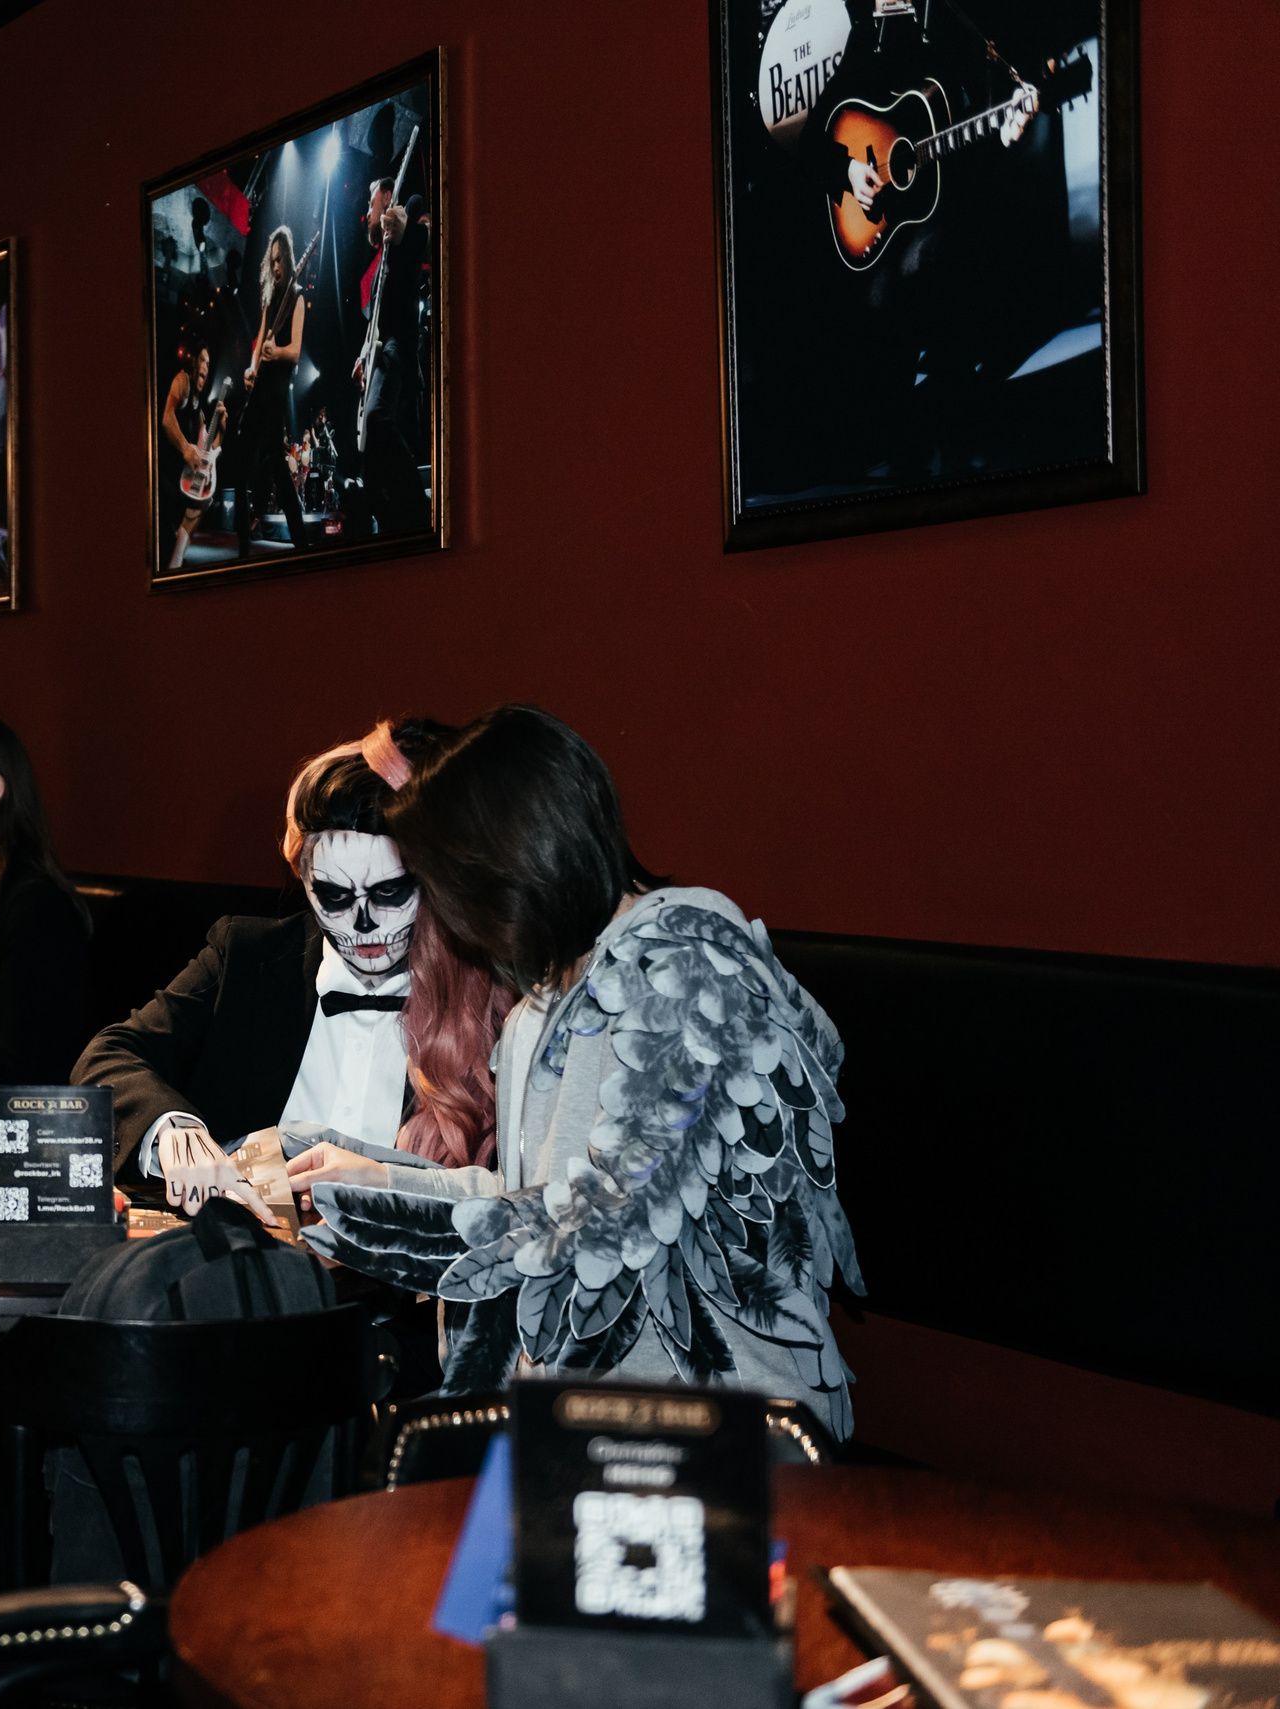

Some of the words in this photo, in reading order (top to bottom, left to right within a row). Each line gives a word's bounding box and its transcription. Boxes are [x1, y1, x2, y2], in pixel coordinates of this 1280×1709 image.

[793, 40, 812, 62] THE
[13, 1100, 46, 1110] ROCK
[60, 1100, 84, 1110] BAR
[13, 1169, 62, 1178] @rockbar_irk
[36, 1204, 95, 1212] t.me/RockBar38
